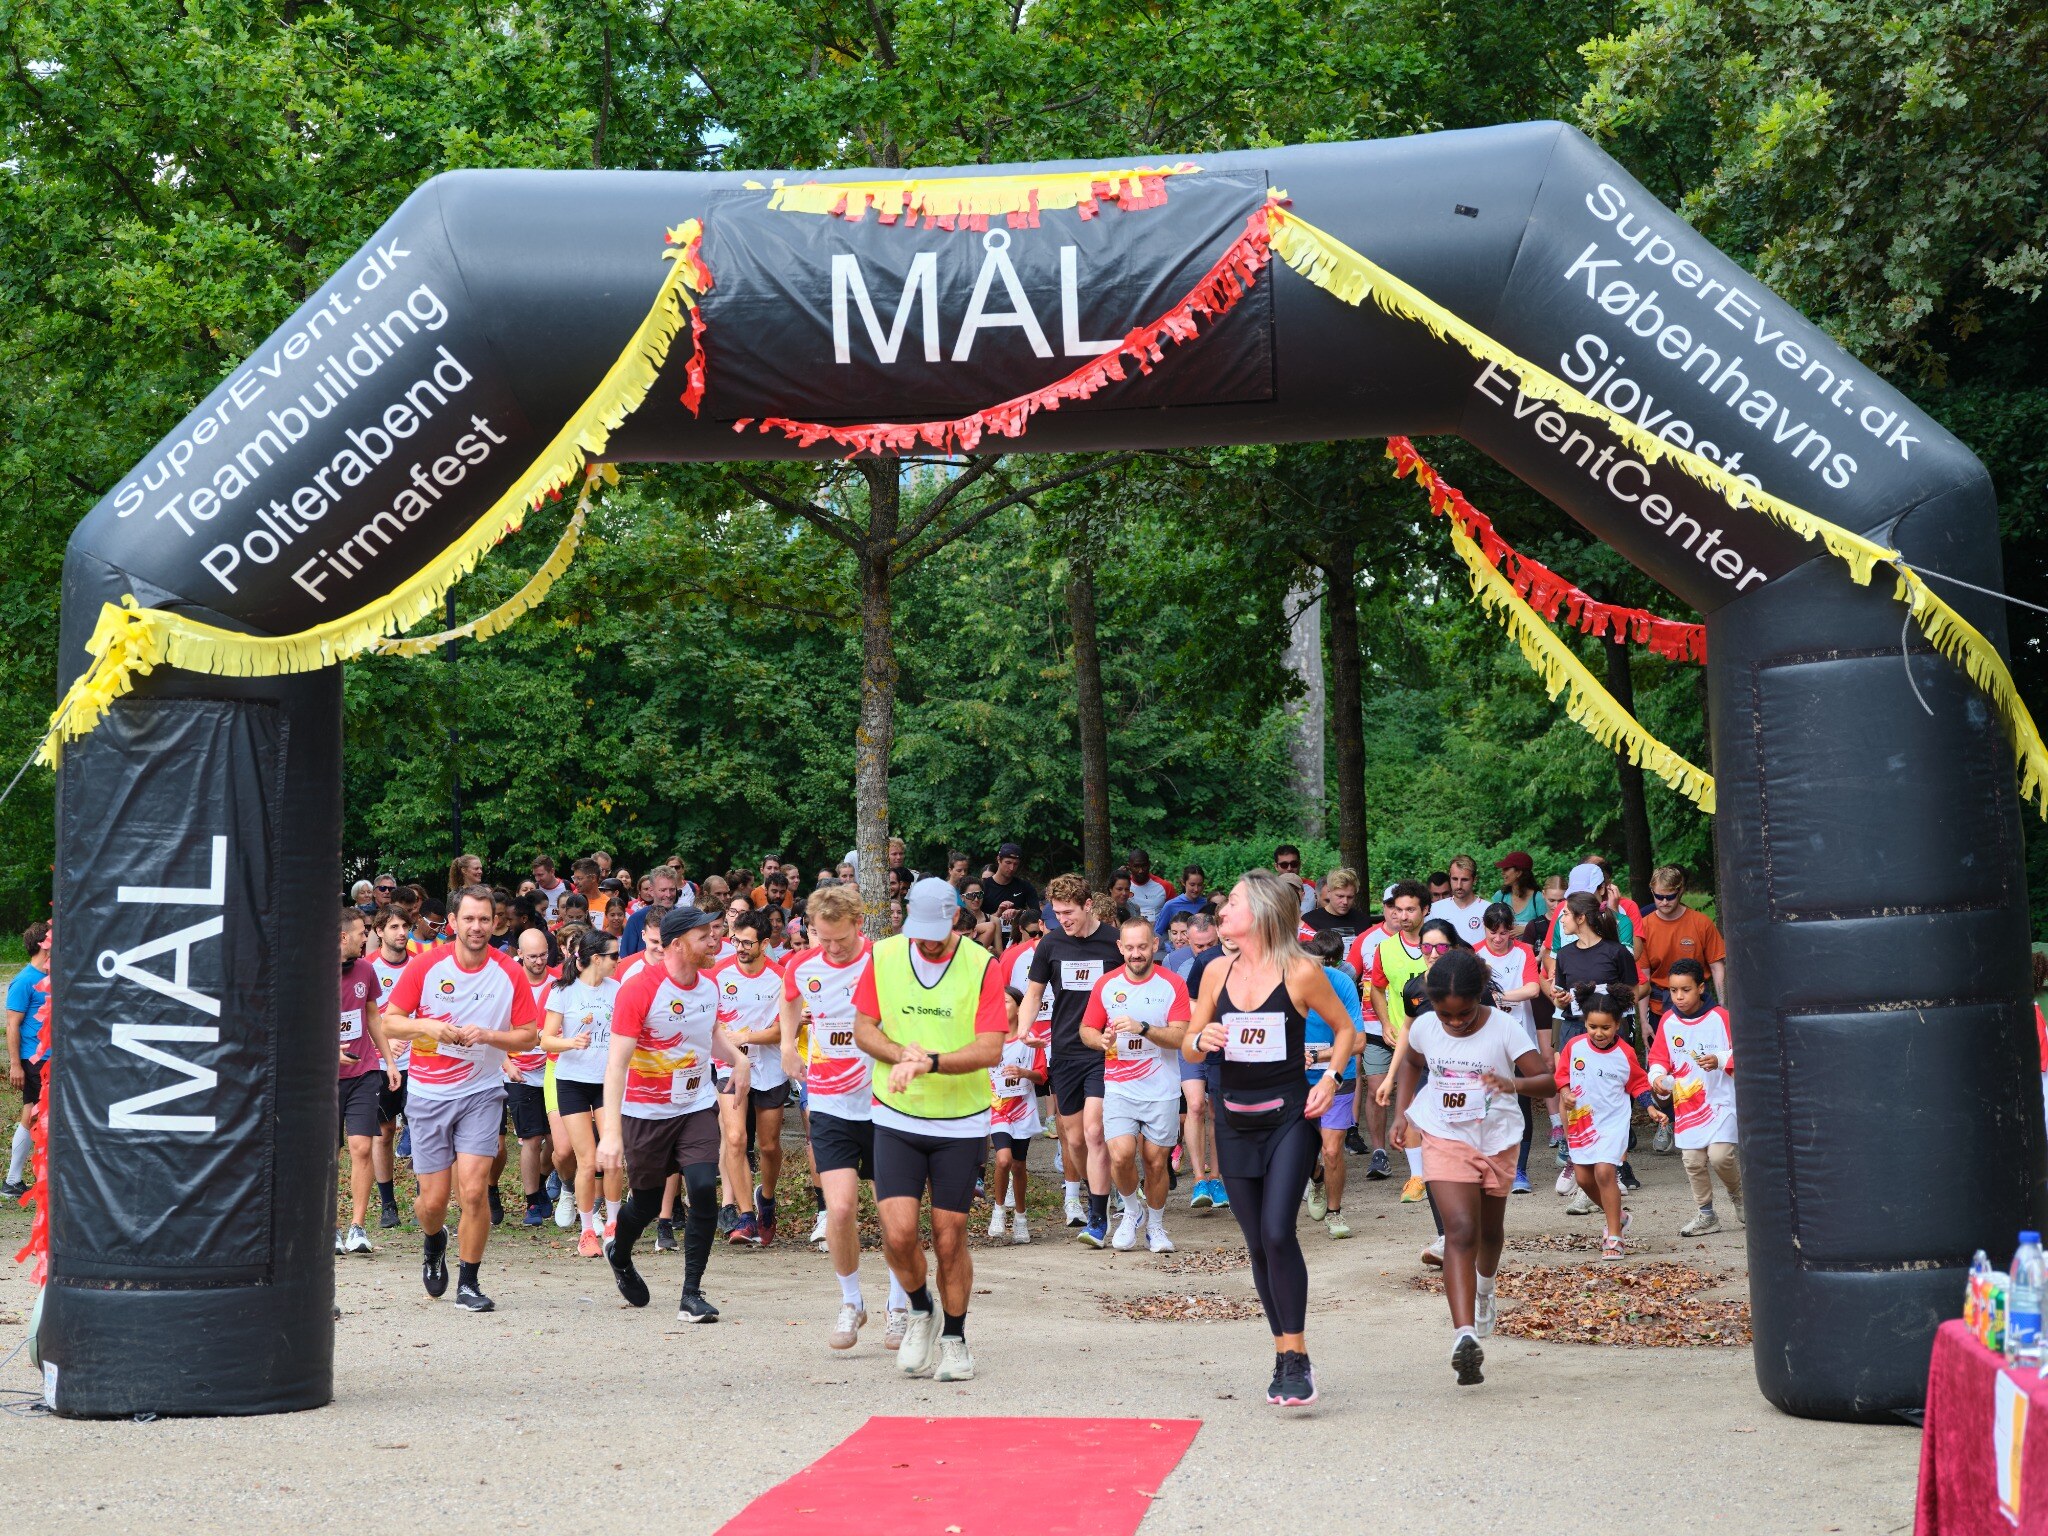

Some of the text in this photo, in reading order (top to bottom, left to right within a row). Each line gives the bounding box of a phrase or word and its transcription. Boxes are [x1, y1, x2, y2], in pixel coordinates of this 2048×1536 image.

[831, 228, 1130, 363] MÅL
[1563, 243, 1858, 489] Københavns
[1585, 183, 1920, 460] SuperEvent.dk
[113, 237, 411, 517] SuperEvent.dk
[155, 283, 449, 537] Teambuilding
[200, 345, 473, 594] Polterabend
[291, 414, 507, 602] Firmafest
[1473, 358, 1768, 592] EventCenter
[96, 836, 227, 1131] MÅL
[830, 1032, 852, 1045] 002
[917, 1006, 951, 1017] Sondico
[1075, 969, 1089, 980] 141
[1128, 1039, 1142, 1050] 011
[1240, 1028, 1265, 1044] 079
[685, 1077, 700, 1090] 001
[1443, 1093, 1466, 1108] 068
